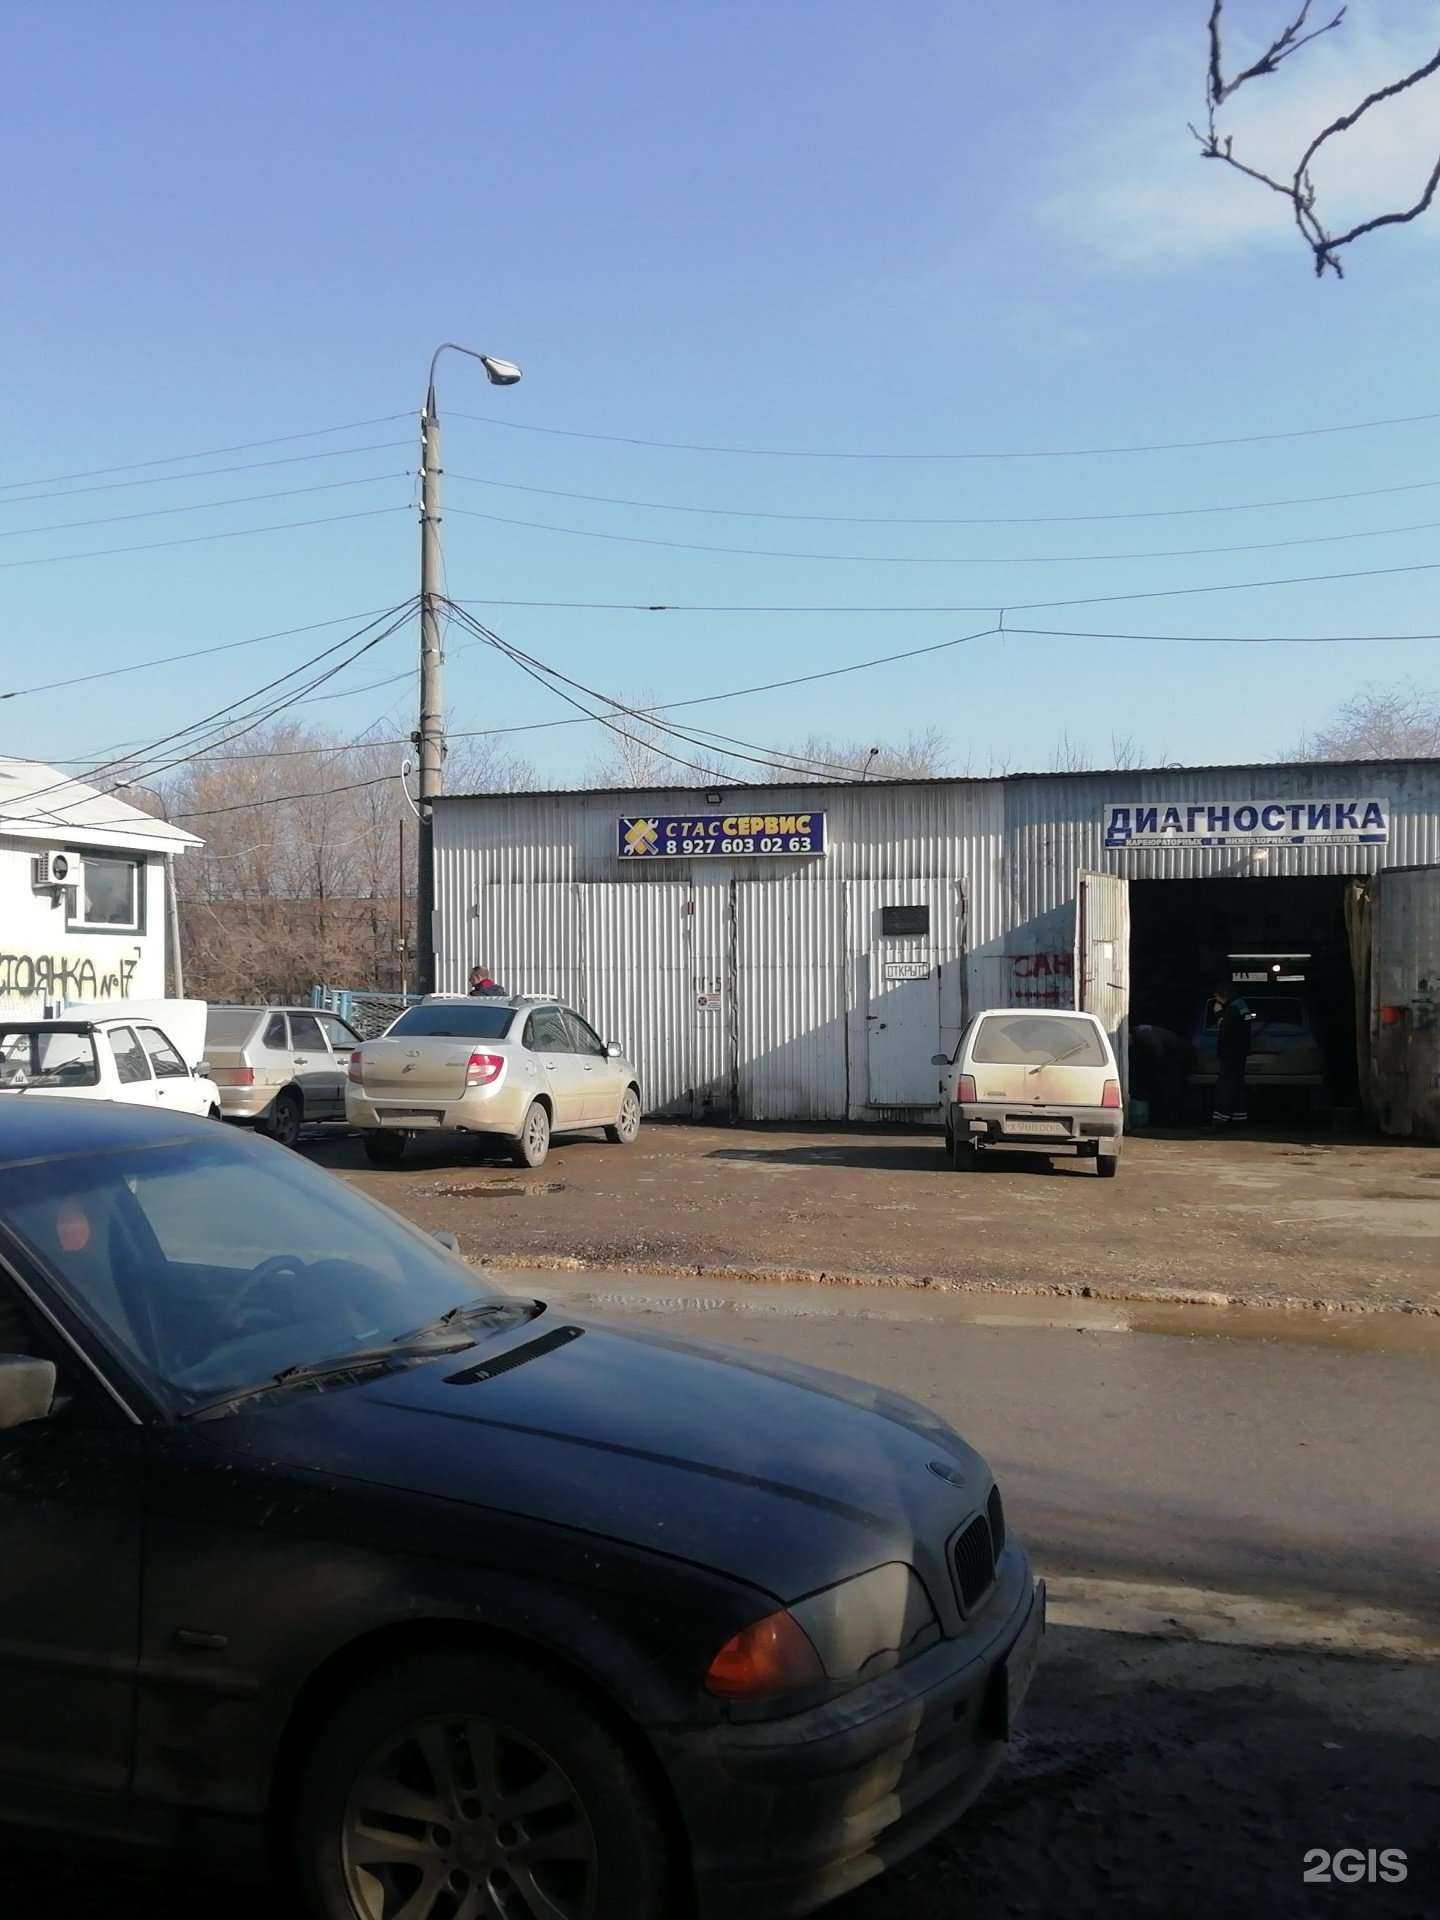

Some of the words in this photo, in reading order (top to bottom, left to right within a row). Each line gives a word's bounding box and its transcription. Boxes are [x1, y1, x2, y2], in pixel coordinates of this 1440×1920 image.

[665, 822, 720, 837] СТАС
[722, 815, 812, 836] СЕРВИС
[1107, 802, 1386, 839] ДИАГНОСТИКА
[666, 840, 677, 854] 8
[682, 839, 715, 854] 927
[721, 838, 754, 853] 603
[760, 838, 783, 852] 02
[788, 837, 812, 852] 63
